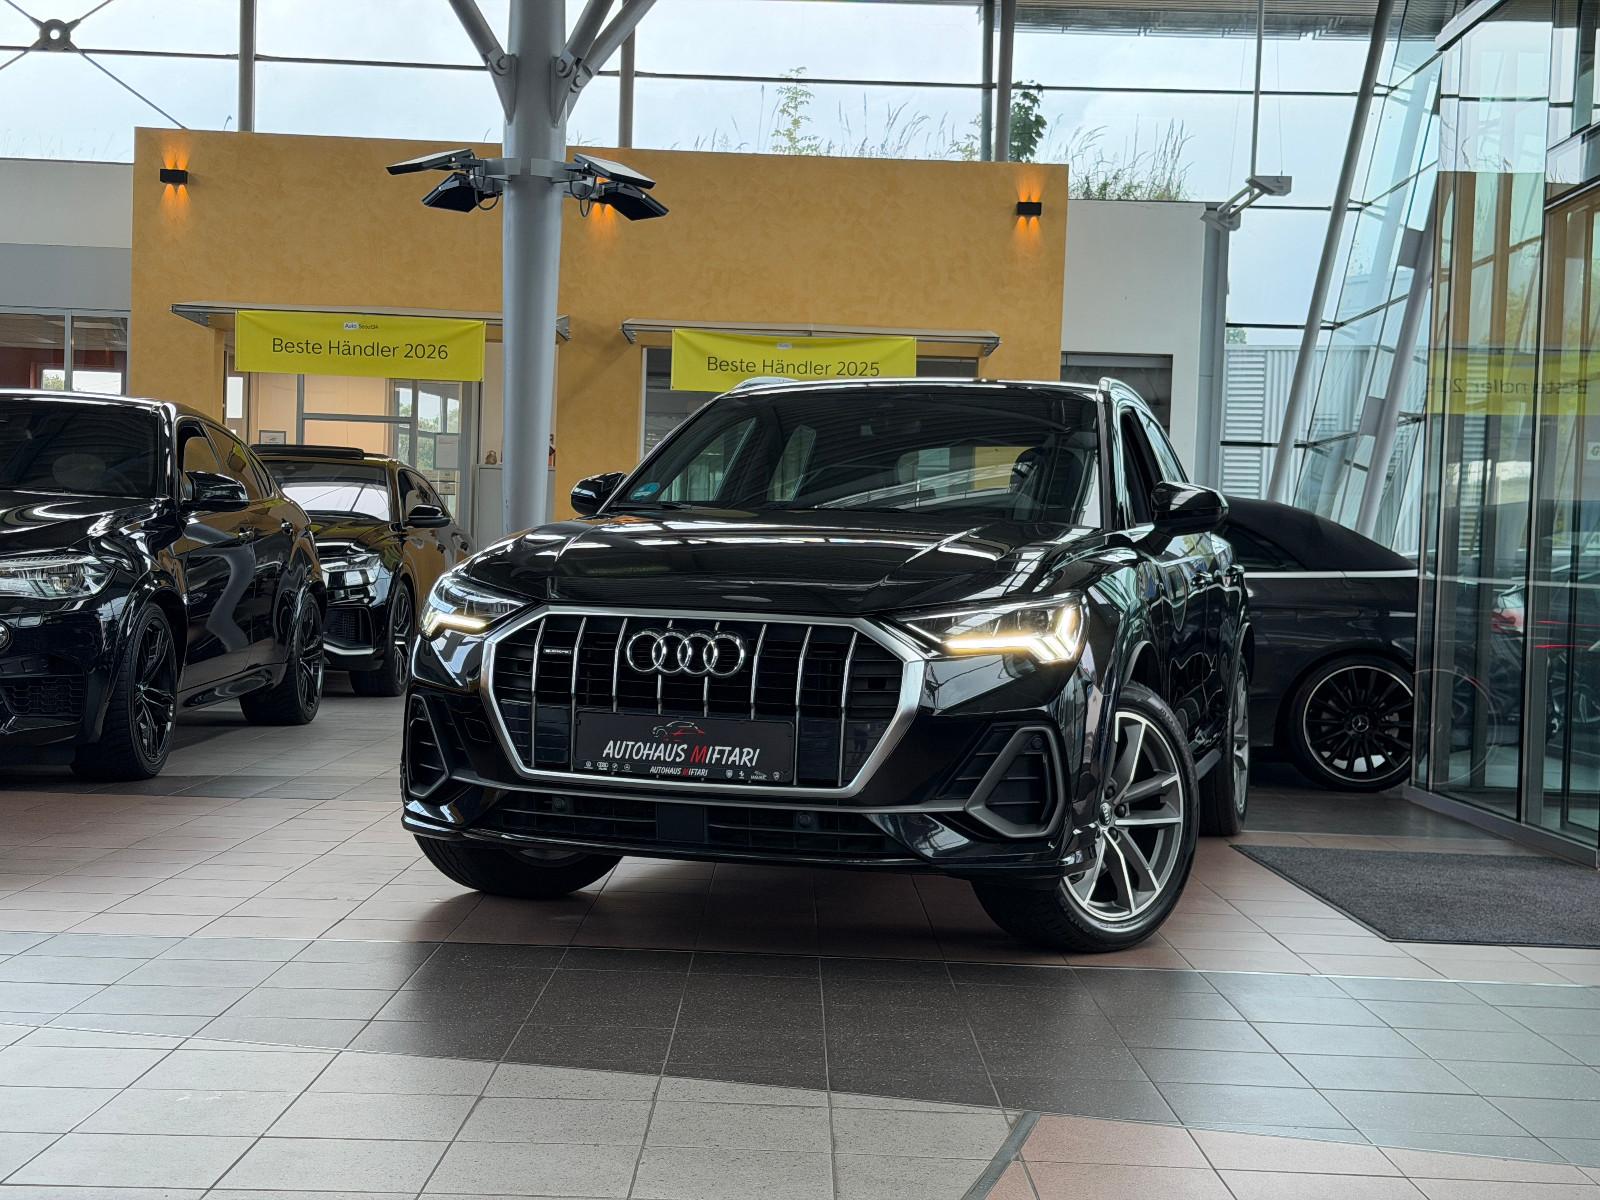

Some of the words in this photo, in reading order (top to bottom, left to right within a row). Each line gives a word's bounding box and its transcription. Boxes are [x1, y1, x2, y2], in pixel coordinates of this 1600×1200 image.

[272, 337, 323, 355] Beste
[328, 340, 400, 358] Händler
[403, 343, 449, 360] 2026
[707, 356, 757, 373] Beste
[762, 359, 832, 375] Händler
[836, 361, 881, 377] 2025
[602, 740, 688, 763] AUTOHAUS
[689, 745, 761, 768] MIFTARI
[649, 766, 682, 775] AUTOHAUS
[682, 768, 709, 777] MIFTARI
